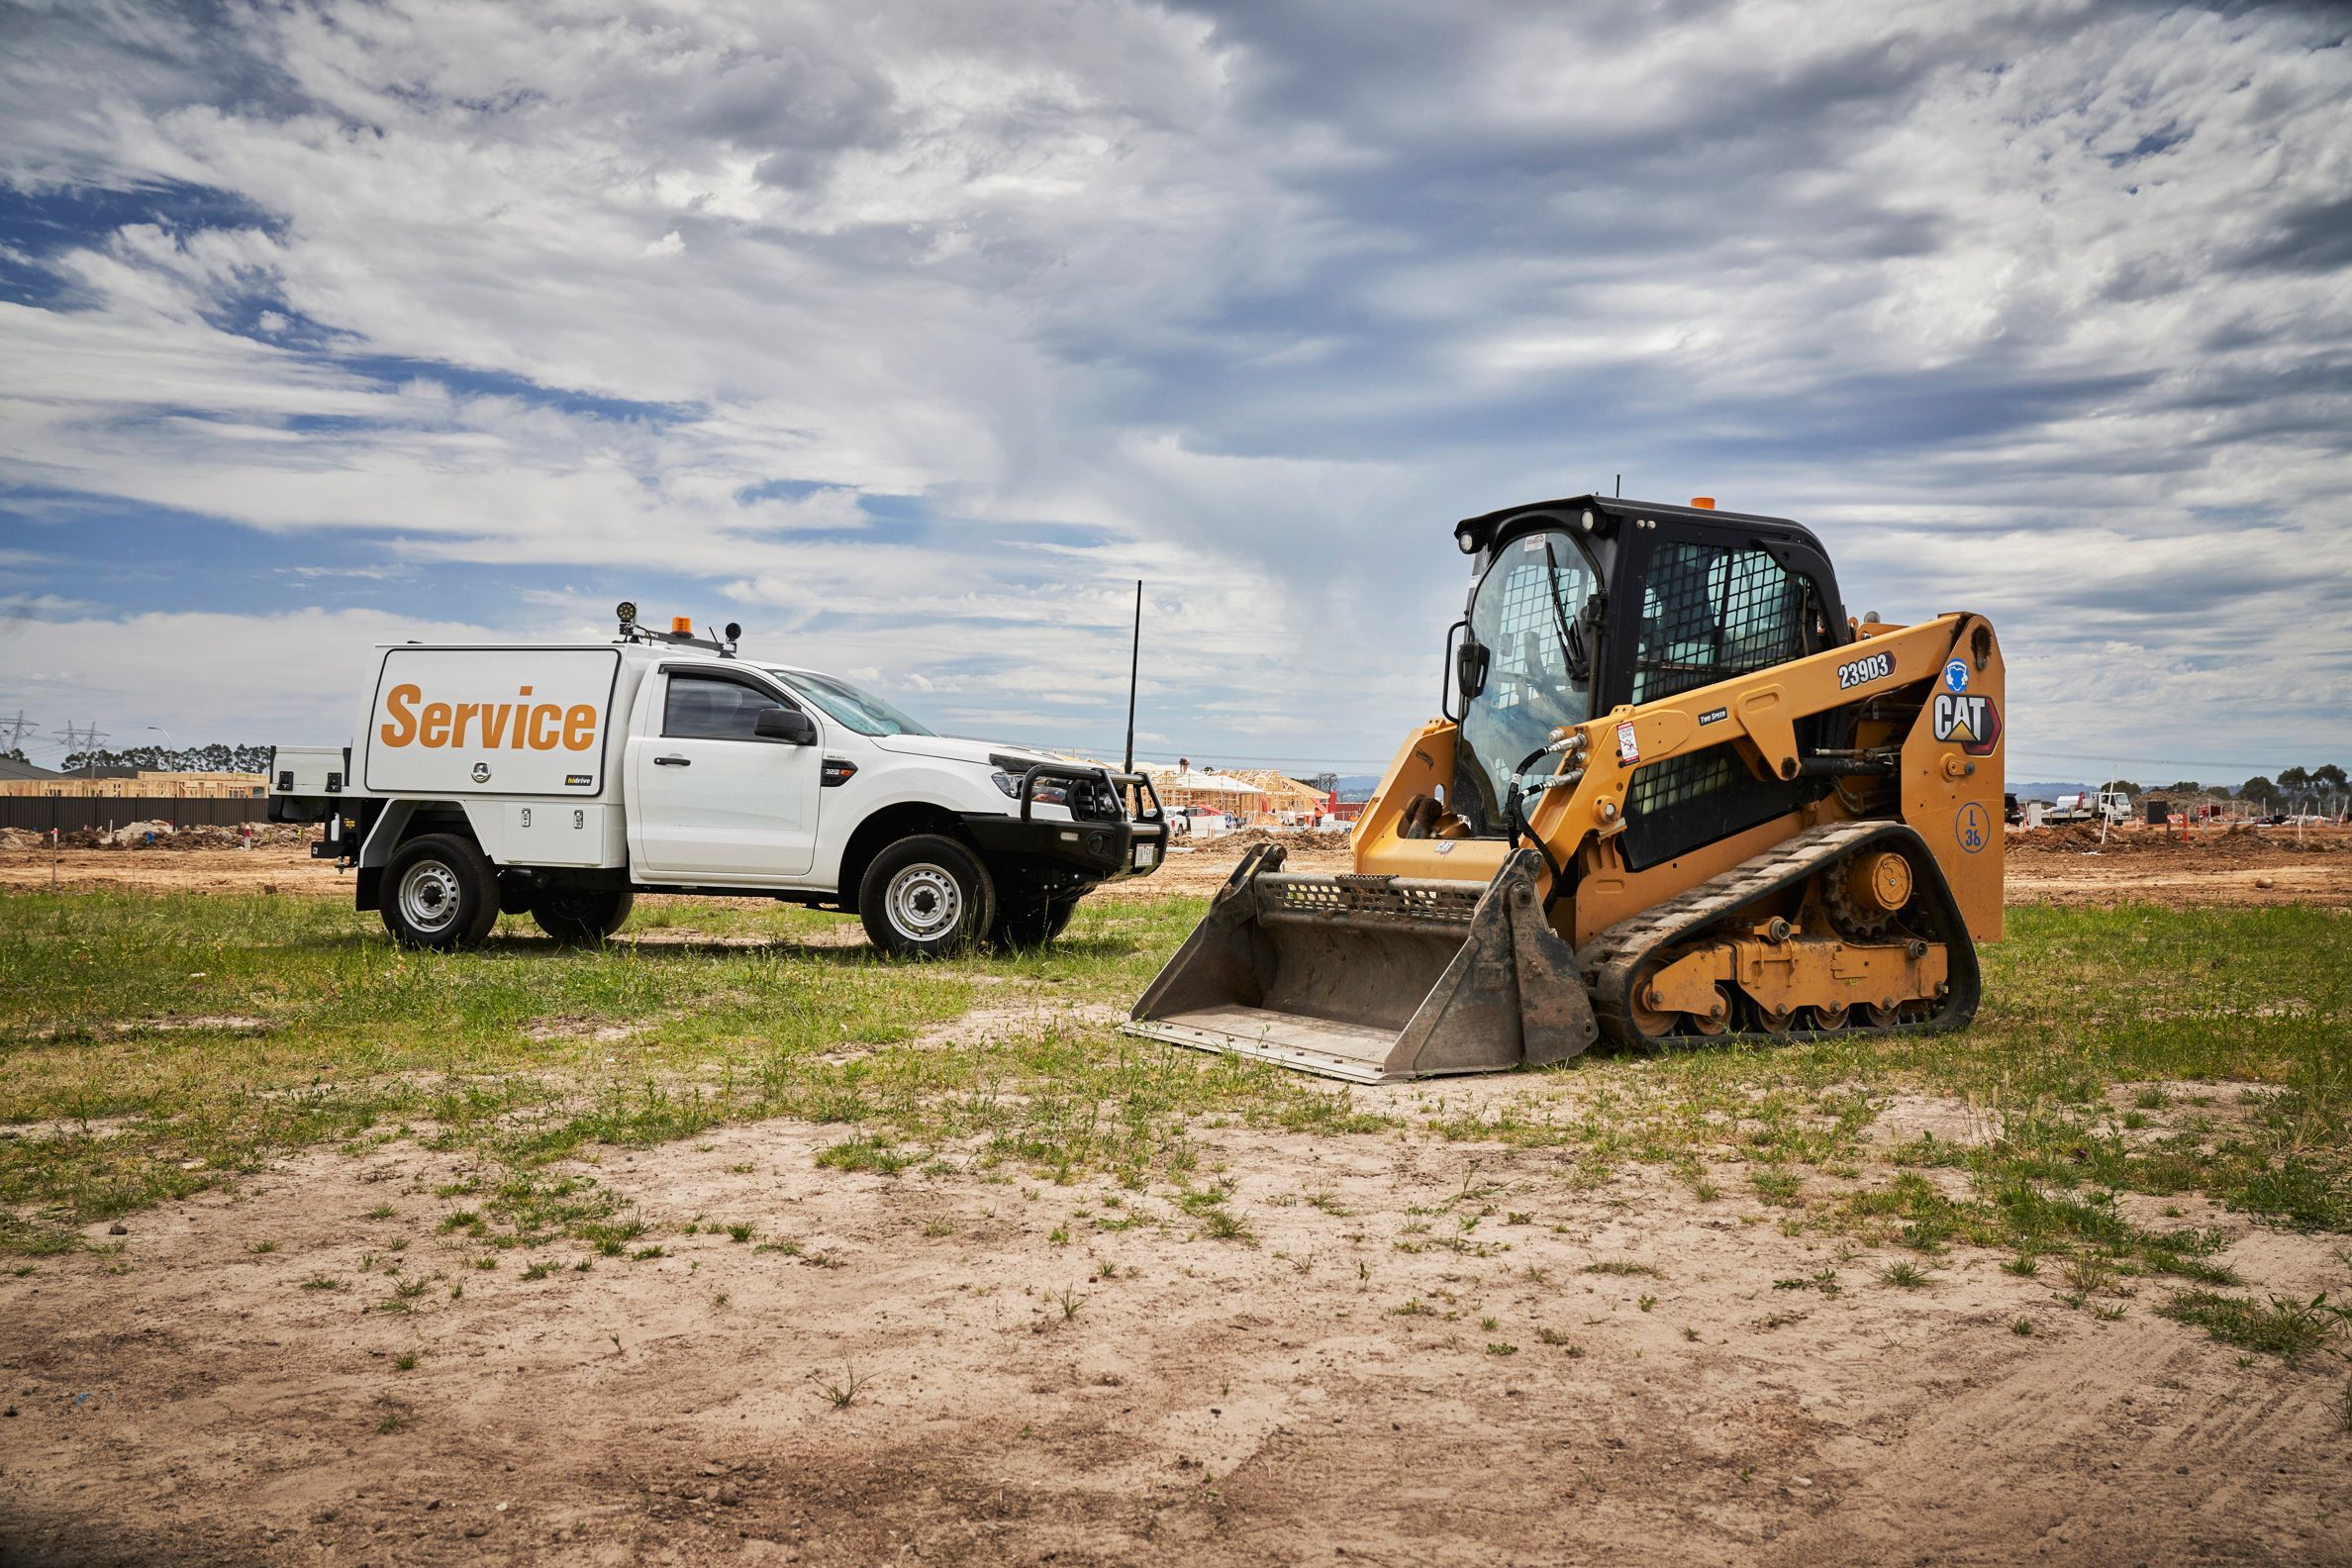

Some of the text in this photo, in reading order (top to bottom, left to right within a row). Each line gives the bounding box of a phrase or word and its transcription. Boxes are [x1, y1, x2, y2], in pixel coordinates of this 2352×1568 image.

[1838, 653, 1889, 689] 239D3
[380, 684, 597, 751] Service
[1934, 694, 1986, 741] CAT
[1969, 808, 1977, 827] L
[1965, 829, 1981, 846] 36
